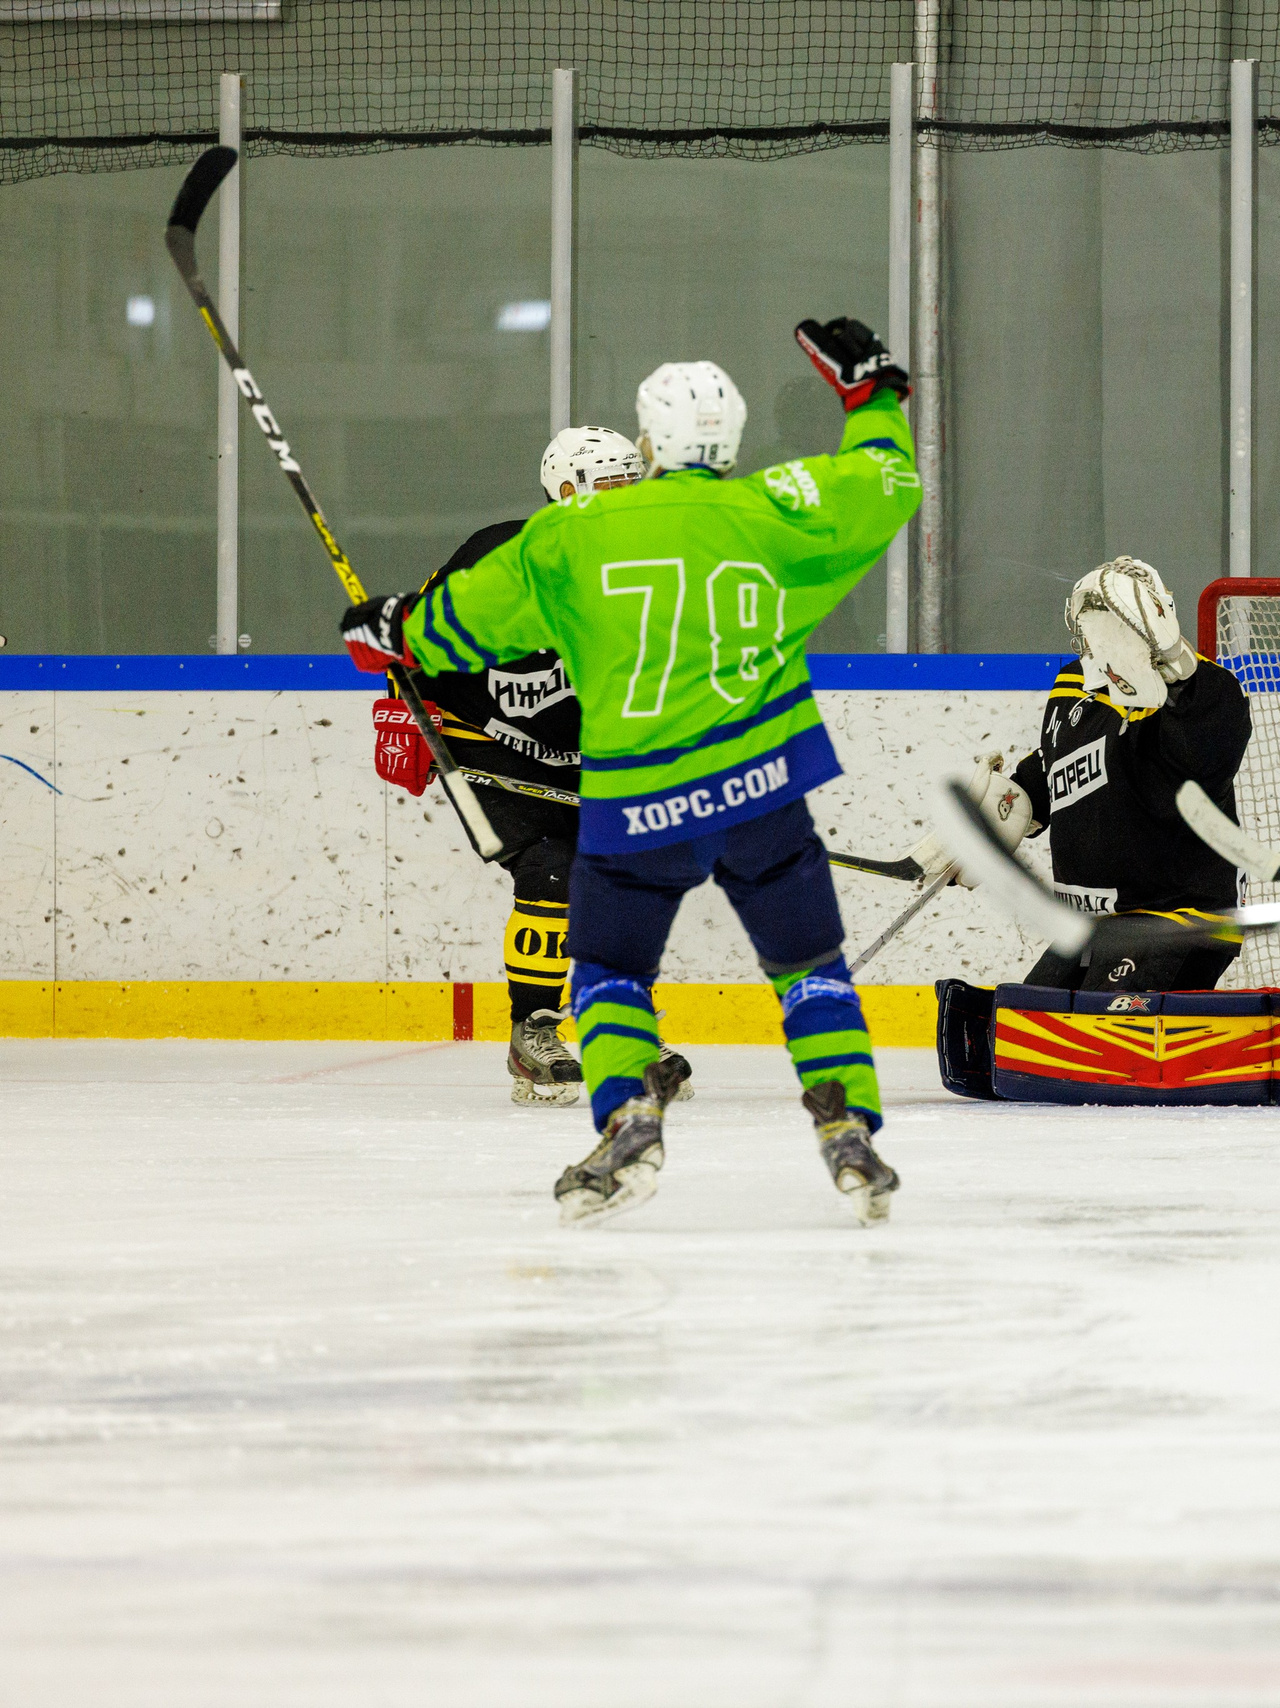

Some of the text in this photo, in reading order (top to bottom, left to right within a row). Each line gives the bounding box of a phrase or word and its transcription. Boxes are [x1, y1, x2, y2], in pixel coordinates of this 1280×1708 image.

[233, 368, 300, 472] CCM
[696, 443, 719, 462] 78
[601, 558, 786, 718] 78
[462, 771, 492, 786] CM
[622, 756, 789, 835] XOPC.COM
